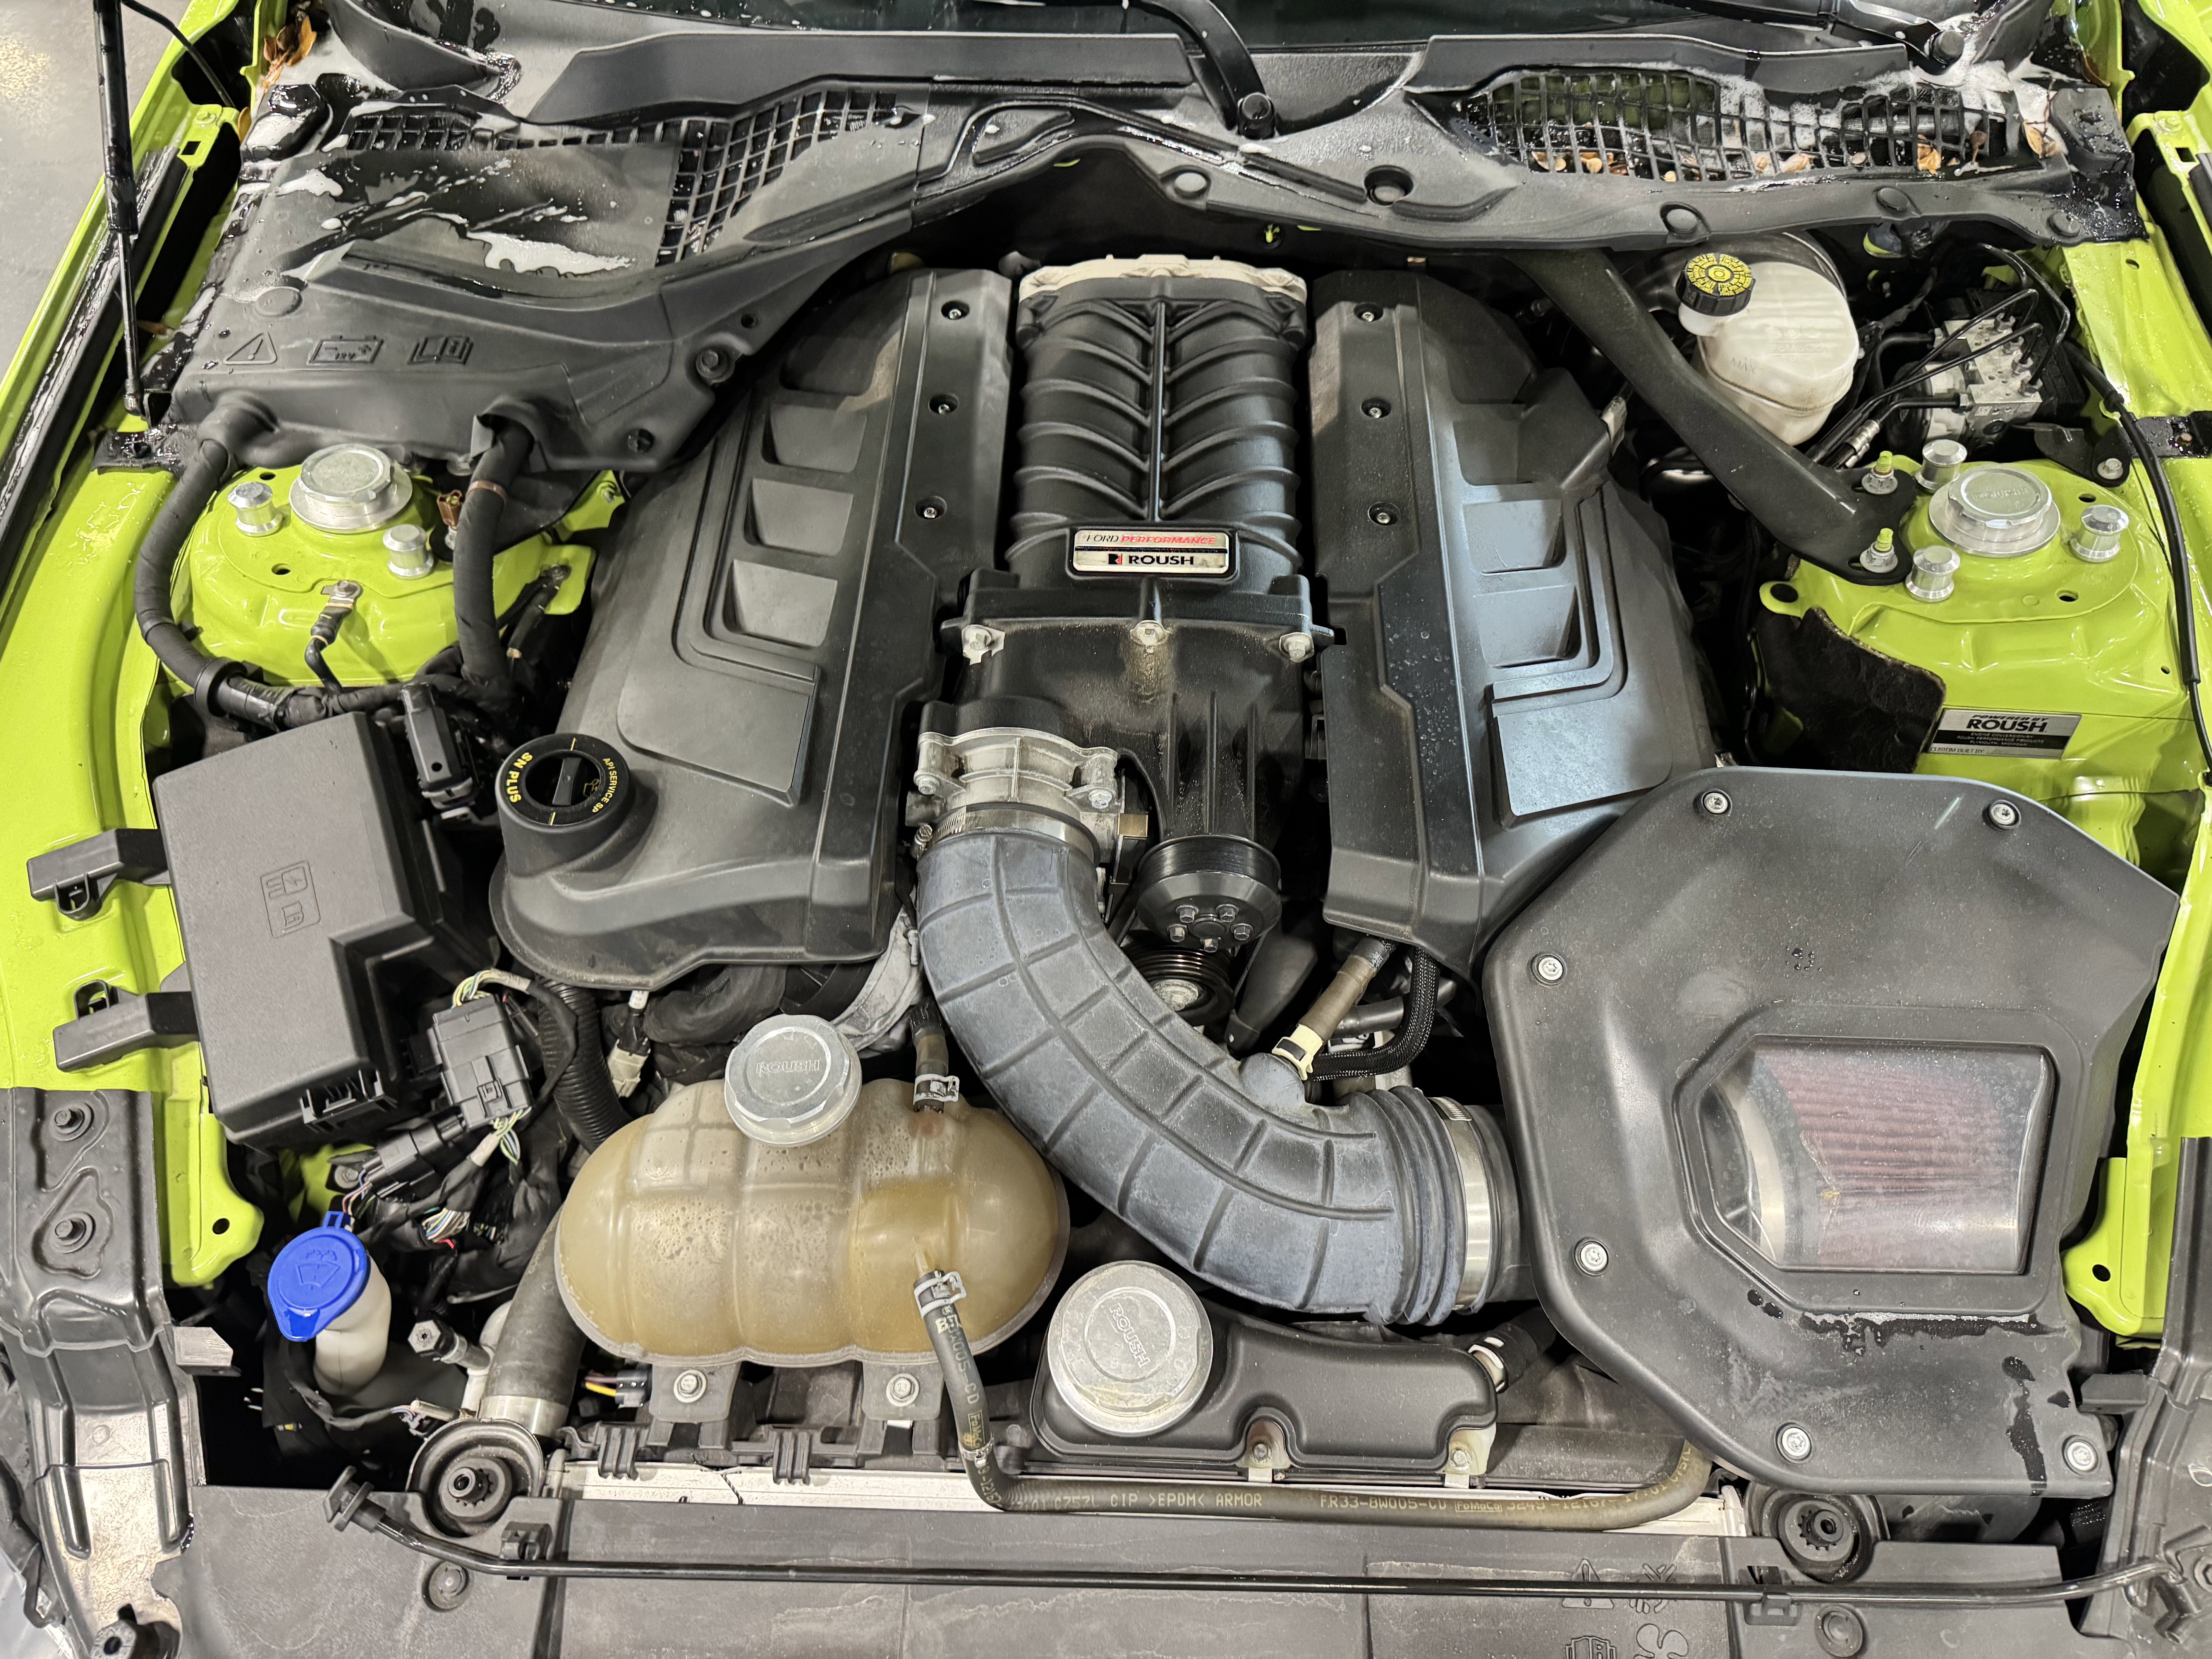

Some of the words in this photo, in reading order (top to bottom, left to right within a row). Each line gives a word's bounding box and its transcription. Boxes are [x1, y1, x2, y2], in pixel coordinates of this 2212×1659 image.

[1086, 534, 1119, 543] FORD
[1121, 534, 1217, 544] PERFORMANCE
[1128, 555, 1194, 565] ROUSH
[1966, 719, 2047, 732] ROUSH
[513, 752, 533, 769] SN
[603, 757, 614, 770] API
[506, 771, 522, 803] PLUS
[601, 771, 618, 804] SERVICE
[592, 802, 604, 813] SP
[756, 1059, 820, 1074] ROUSH
[1109, 1303, 1151, 1369] ROUSH
[1111, 1494, 1138, 1506] CIP
[1216, 1493, 1262, 1507] ARMOR
